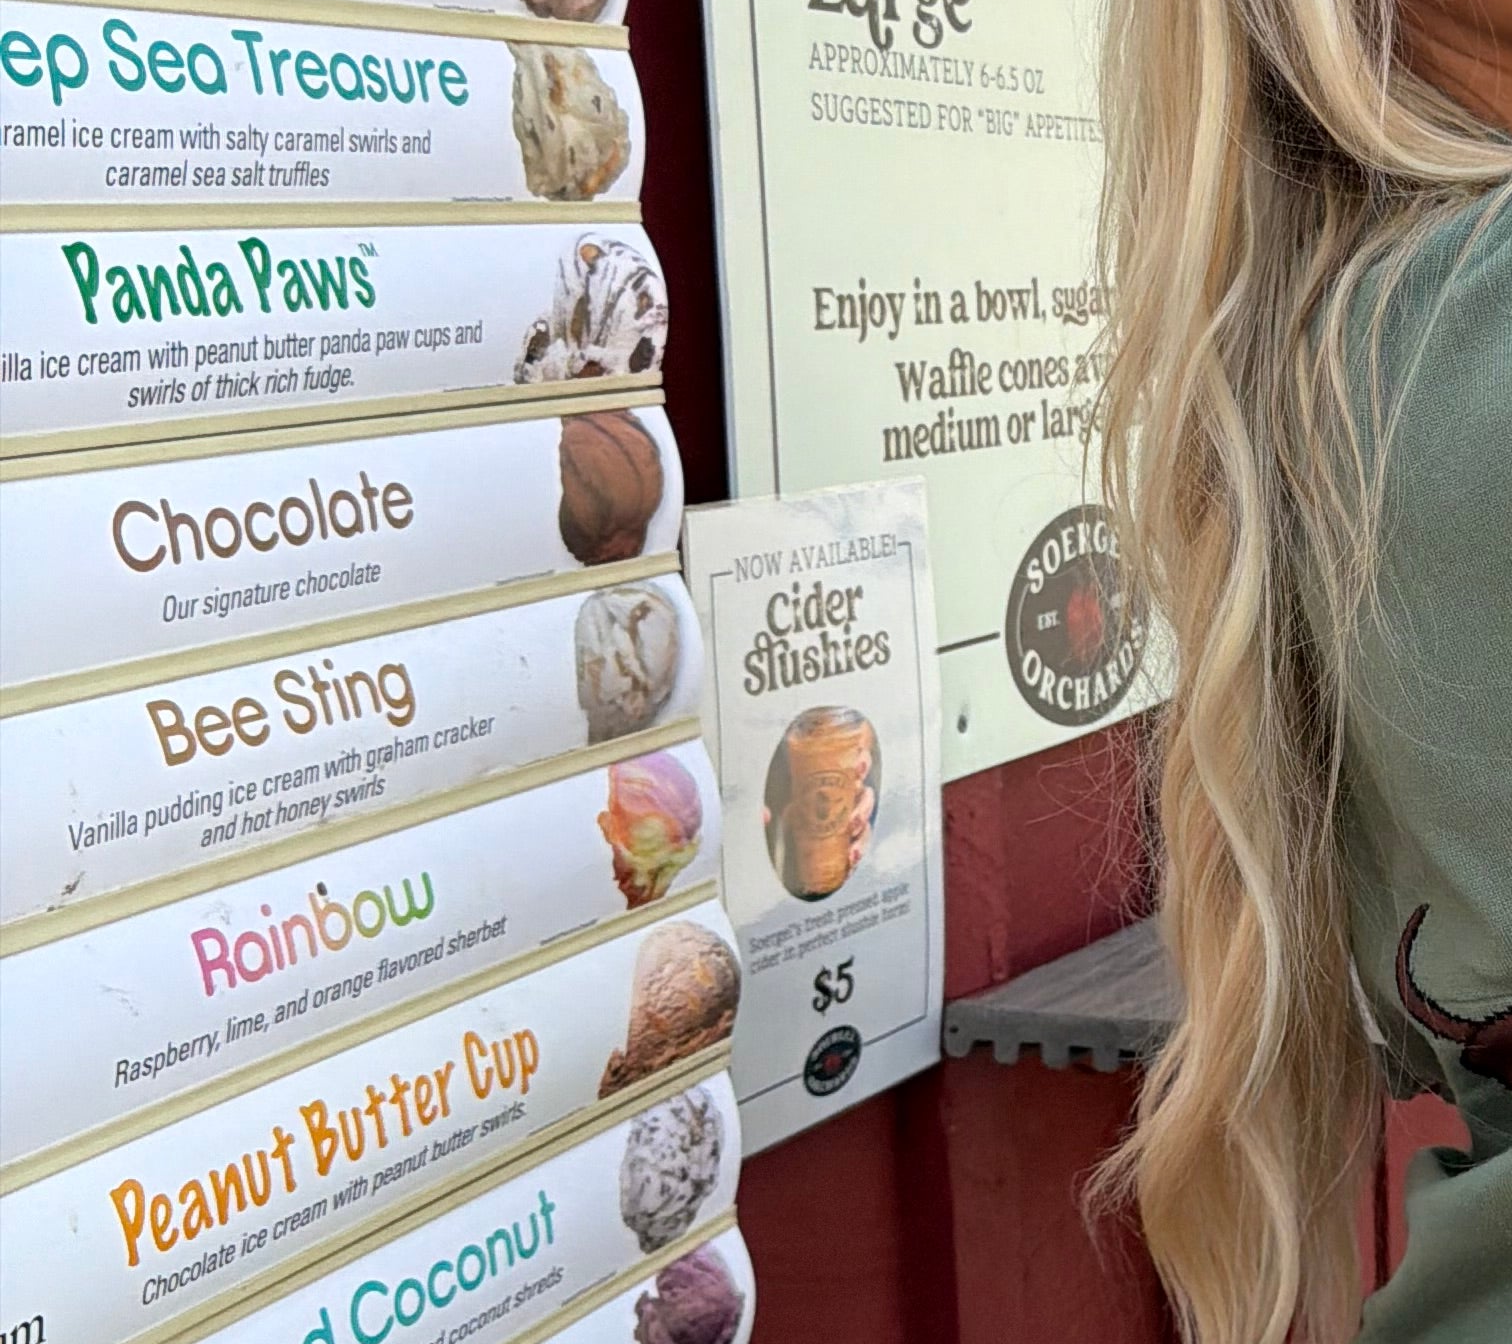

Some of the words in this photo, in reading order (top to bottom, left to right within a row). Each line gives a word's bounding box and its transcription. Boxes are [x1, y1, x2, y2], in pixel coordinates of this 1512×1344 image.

[102, 18, 227, 95] Sea
[231, 29, 470, 107] Treasure
[808, 42, 974, 87] APPROXIMATELY
[979, 64, 1019, 93] 6-6.5
[1023, 68, 1045, 94] OZ
[811, 92, 930, 130] SUGGESTED
[938, 103, 973, 133] FOR
[105, 160, 188, 188] caramel
[192, 164, 225, 188] sea
[231, 161, 264, 186] salt
[267, 161, 330, 186] truffles
[61, 240, 243, 325] Panda
[813, 276, 905, 344] Enjoy
[914, 277, 942, 325] in
[950, 289, 970, 324] a
[975, 276, 1046, 324] bowl,
[895, 347, 992, 402] Waffle
[999, 355, 1069, 392] cones
[883, 411, 1000, 463] medium
[1007, 414, 1035, 444] or
[112, 471, 415, 573] Chocolate
[161, 594, 198, 623] Our
[202, 577, 291, 615] signature
[295, 561, 381, 599] chocolate
[733, 553, 783, 582] NOW
[789, 535, 896, 574] AVAILABLE!
[766, 581, 863, 639] Cider
[744, 626, 891, 696] Slushies
[146, 689, 269, 767] Bee
[274, 657, 416, 734] Sting
[68, 810, 138, 852] Vanilla
[145, 789, 223, 835] pudding
[228, 779, 258, 804] ice
[263, 763, 320, 797] cream
[323, 750, 361, 780] with
[366, 732, 430, 776] graham
[433, 714, 495, 752] cracker
[200, 820, 236, 849] and
[241, 810, 273, 836] hot
[276, 792, 332, 831] honey
[334, 775, 386, 810] swirls
[191, 871, 436, 998] Rainbow
[114, 1028, 221, 1088] Raspberry,
[226, 1012, 268, 1043] lime,
[274, 990, 309, 1022] and
[313, 969, 374, 1012] orange
[378, 938, 444, 985] flavored
[447, 915, 508, 960] sherbet
[812, 957, 855, 1018] $5
[110, 1126, 296, 1267] Peanut
[300, 1061, 456, 1177] Butter
[463, 1027, 539, 1101] Cup
